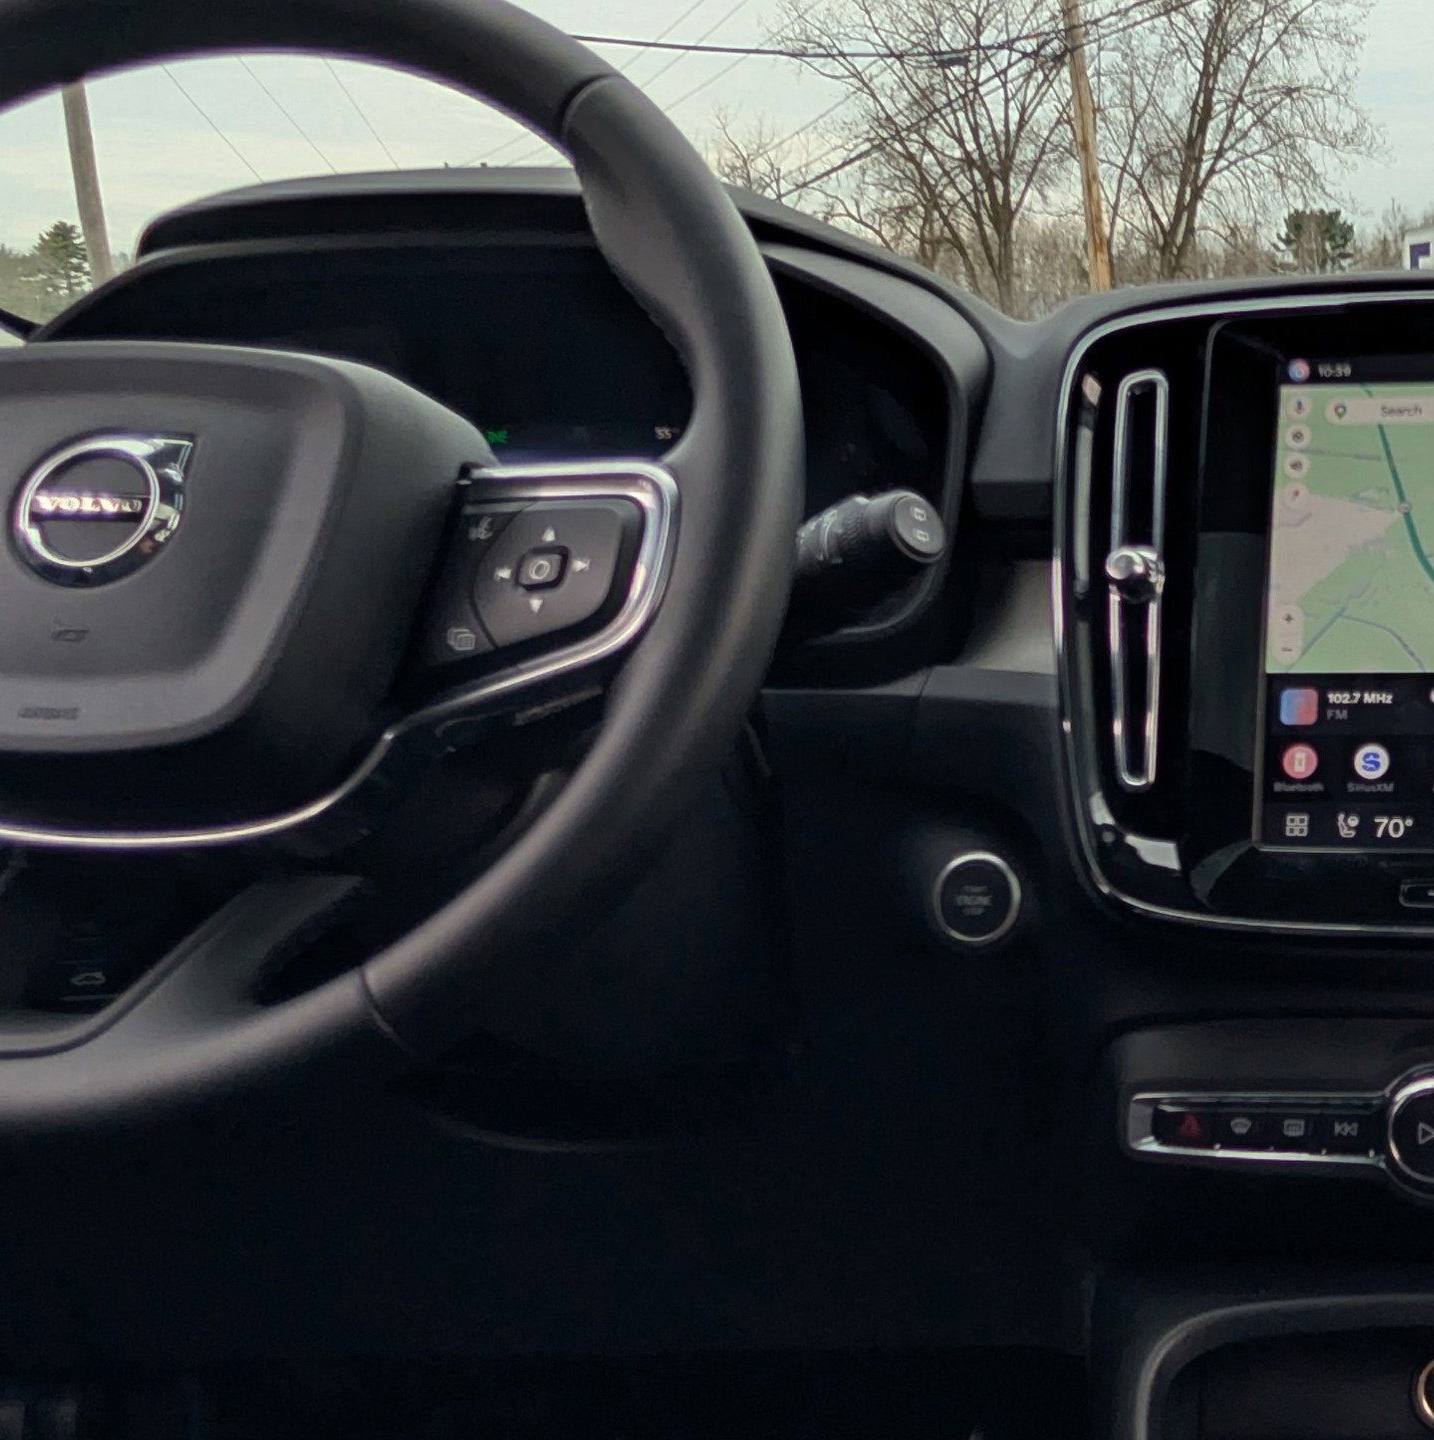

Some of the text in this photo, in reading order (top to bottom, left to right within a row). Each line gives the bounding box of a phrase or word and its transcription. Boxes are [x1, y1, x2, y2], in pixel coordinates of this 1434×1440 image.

[1317, 364, 1352, 378] 10:39
[1381, 405, 1423, 418] Search
[36, 495, 143, 514] VOLVO
[1326, 692, 1393, 704] 102.7 MHz
[1326, 709, 1348, 720] FM
[1346, 782, 1394, 792] SiriusXM
[1373, 816, 1414, 838] 70°
